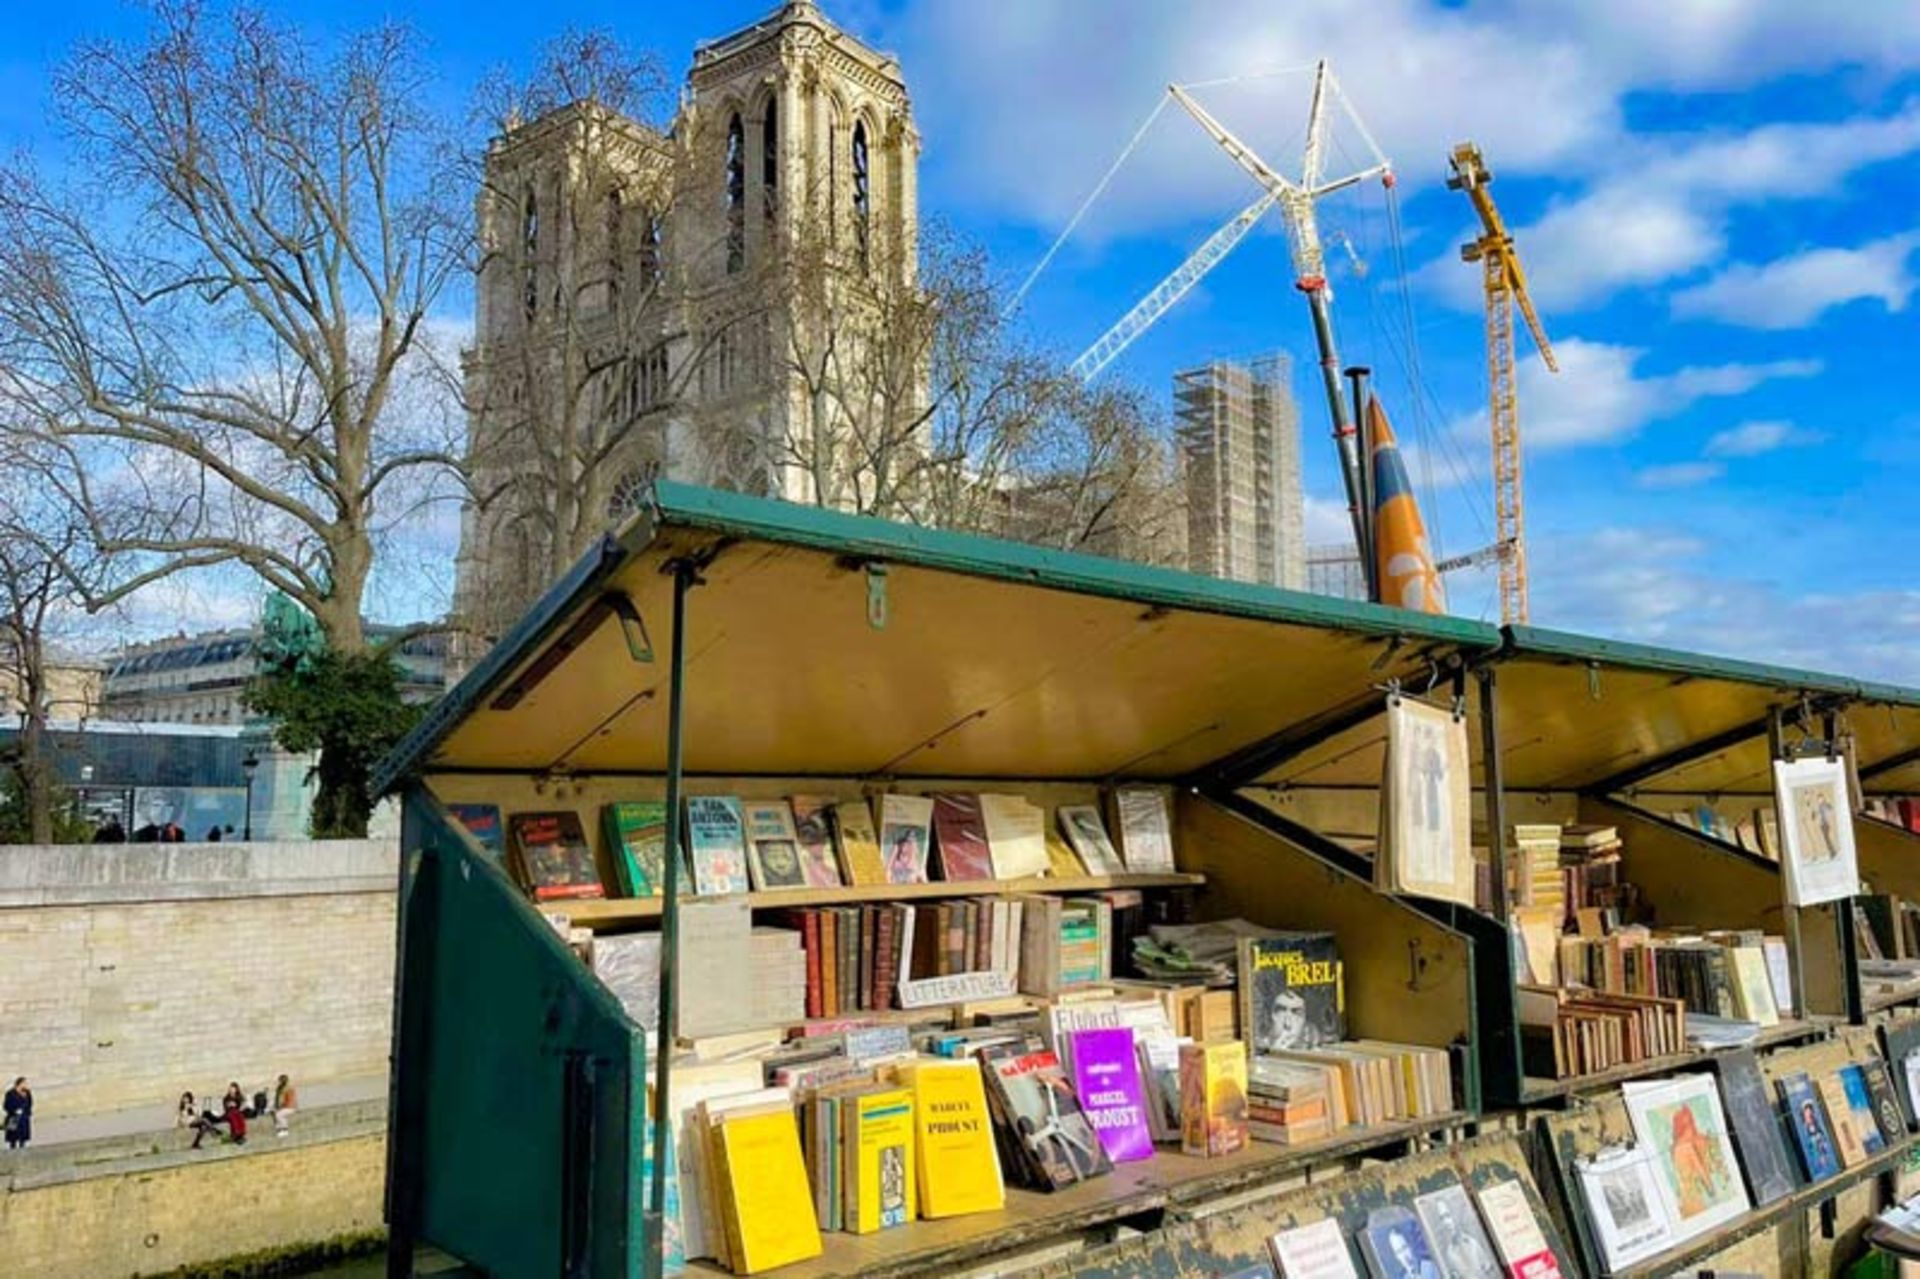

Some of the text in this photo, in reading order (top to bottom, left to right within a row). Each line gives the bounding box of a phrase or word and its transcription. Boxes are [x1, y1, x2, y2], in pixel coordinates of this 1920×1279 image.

[1252, 946, 1305, 972] Jacques
[1286, 961, 1335, 988] BREL
[927, 1119, 979, 1135] PROUST
